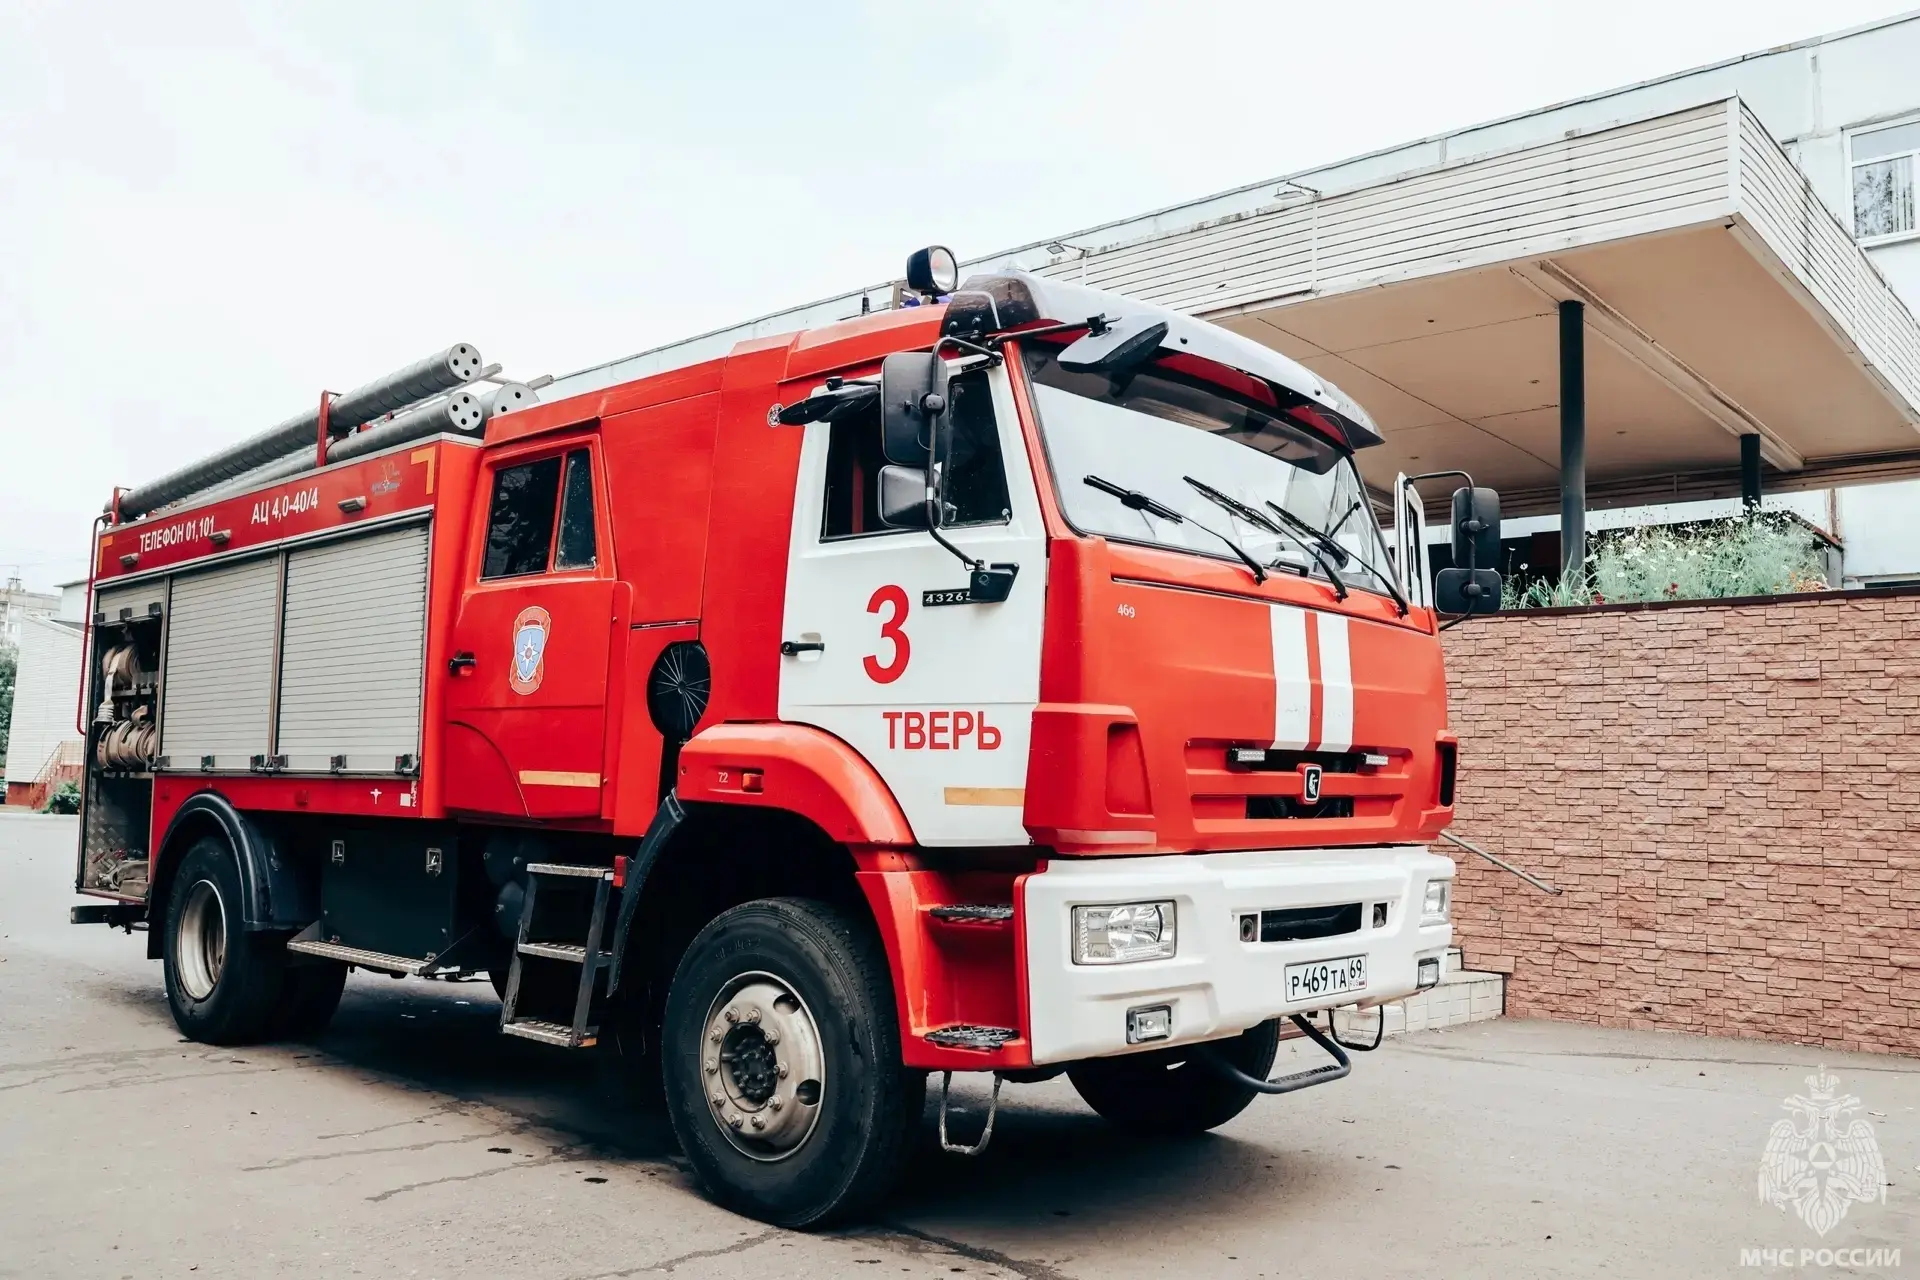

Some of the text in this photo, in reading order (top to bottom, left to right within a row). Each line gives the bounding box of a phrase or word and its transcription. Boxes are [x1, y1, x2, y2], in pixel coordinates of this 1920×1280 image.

[250, 486, 319, 526] АЦ 4,0-40/4
[139, 522, 185, 553] ТЕЛЕФОН
[1117, 603, 1136, 619] 469
[863, 584, 911, 684] 3
[882, 710, 1002, 751] ТВЕРЬ
[717, 771, 729, 784] 72
[1349, 958, 1362, 979] 69
